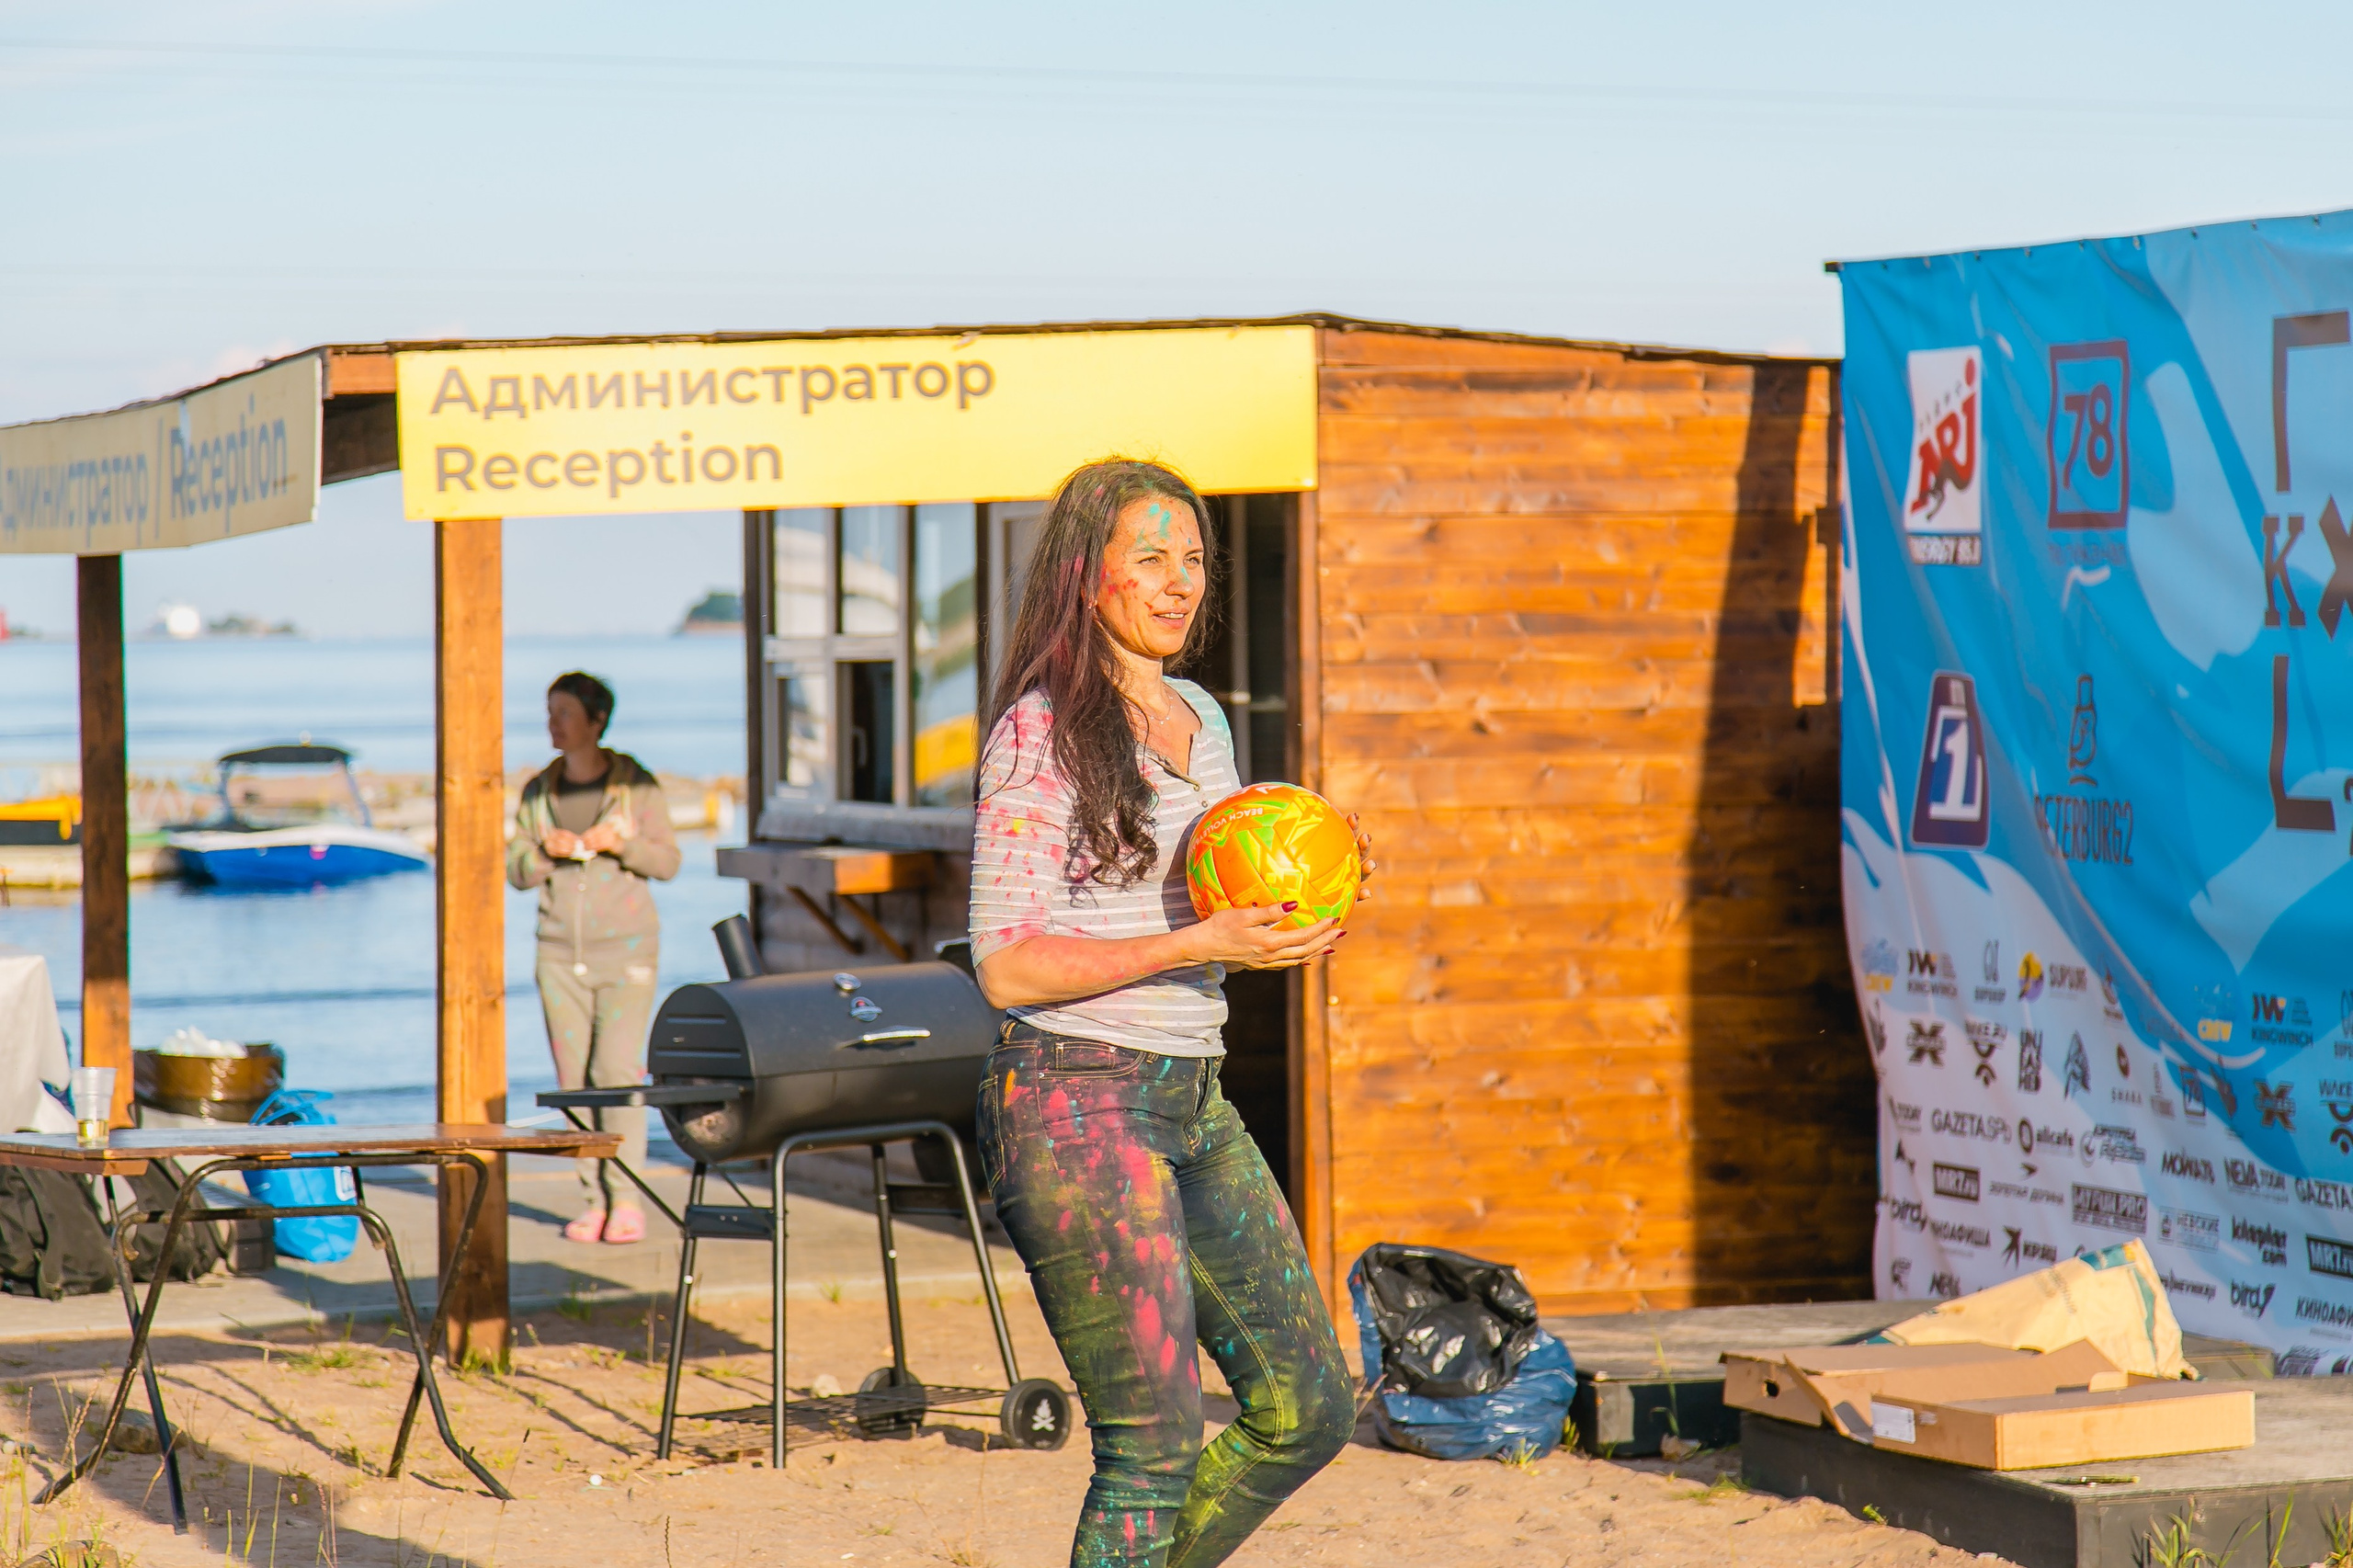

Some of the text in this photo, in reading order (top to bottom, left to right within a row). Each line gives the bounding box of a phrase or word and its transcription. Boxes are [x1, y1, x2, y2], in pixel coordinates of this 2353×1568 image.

[430, 358, 995, 422] Администратор
[0, 452, 149, 549] дминистратор
[169, 392, 289, 536] Reception
[436, 432, 783, 499] Reception
[2064, 383, 2115, 491] 78
[1188, 806, 1264, 857] BEACH VOLLEYBA
